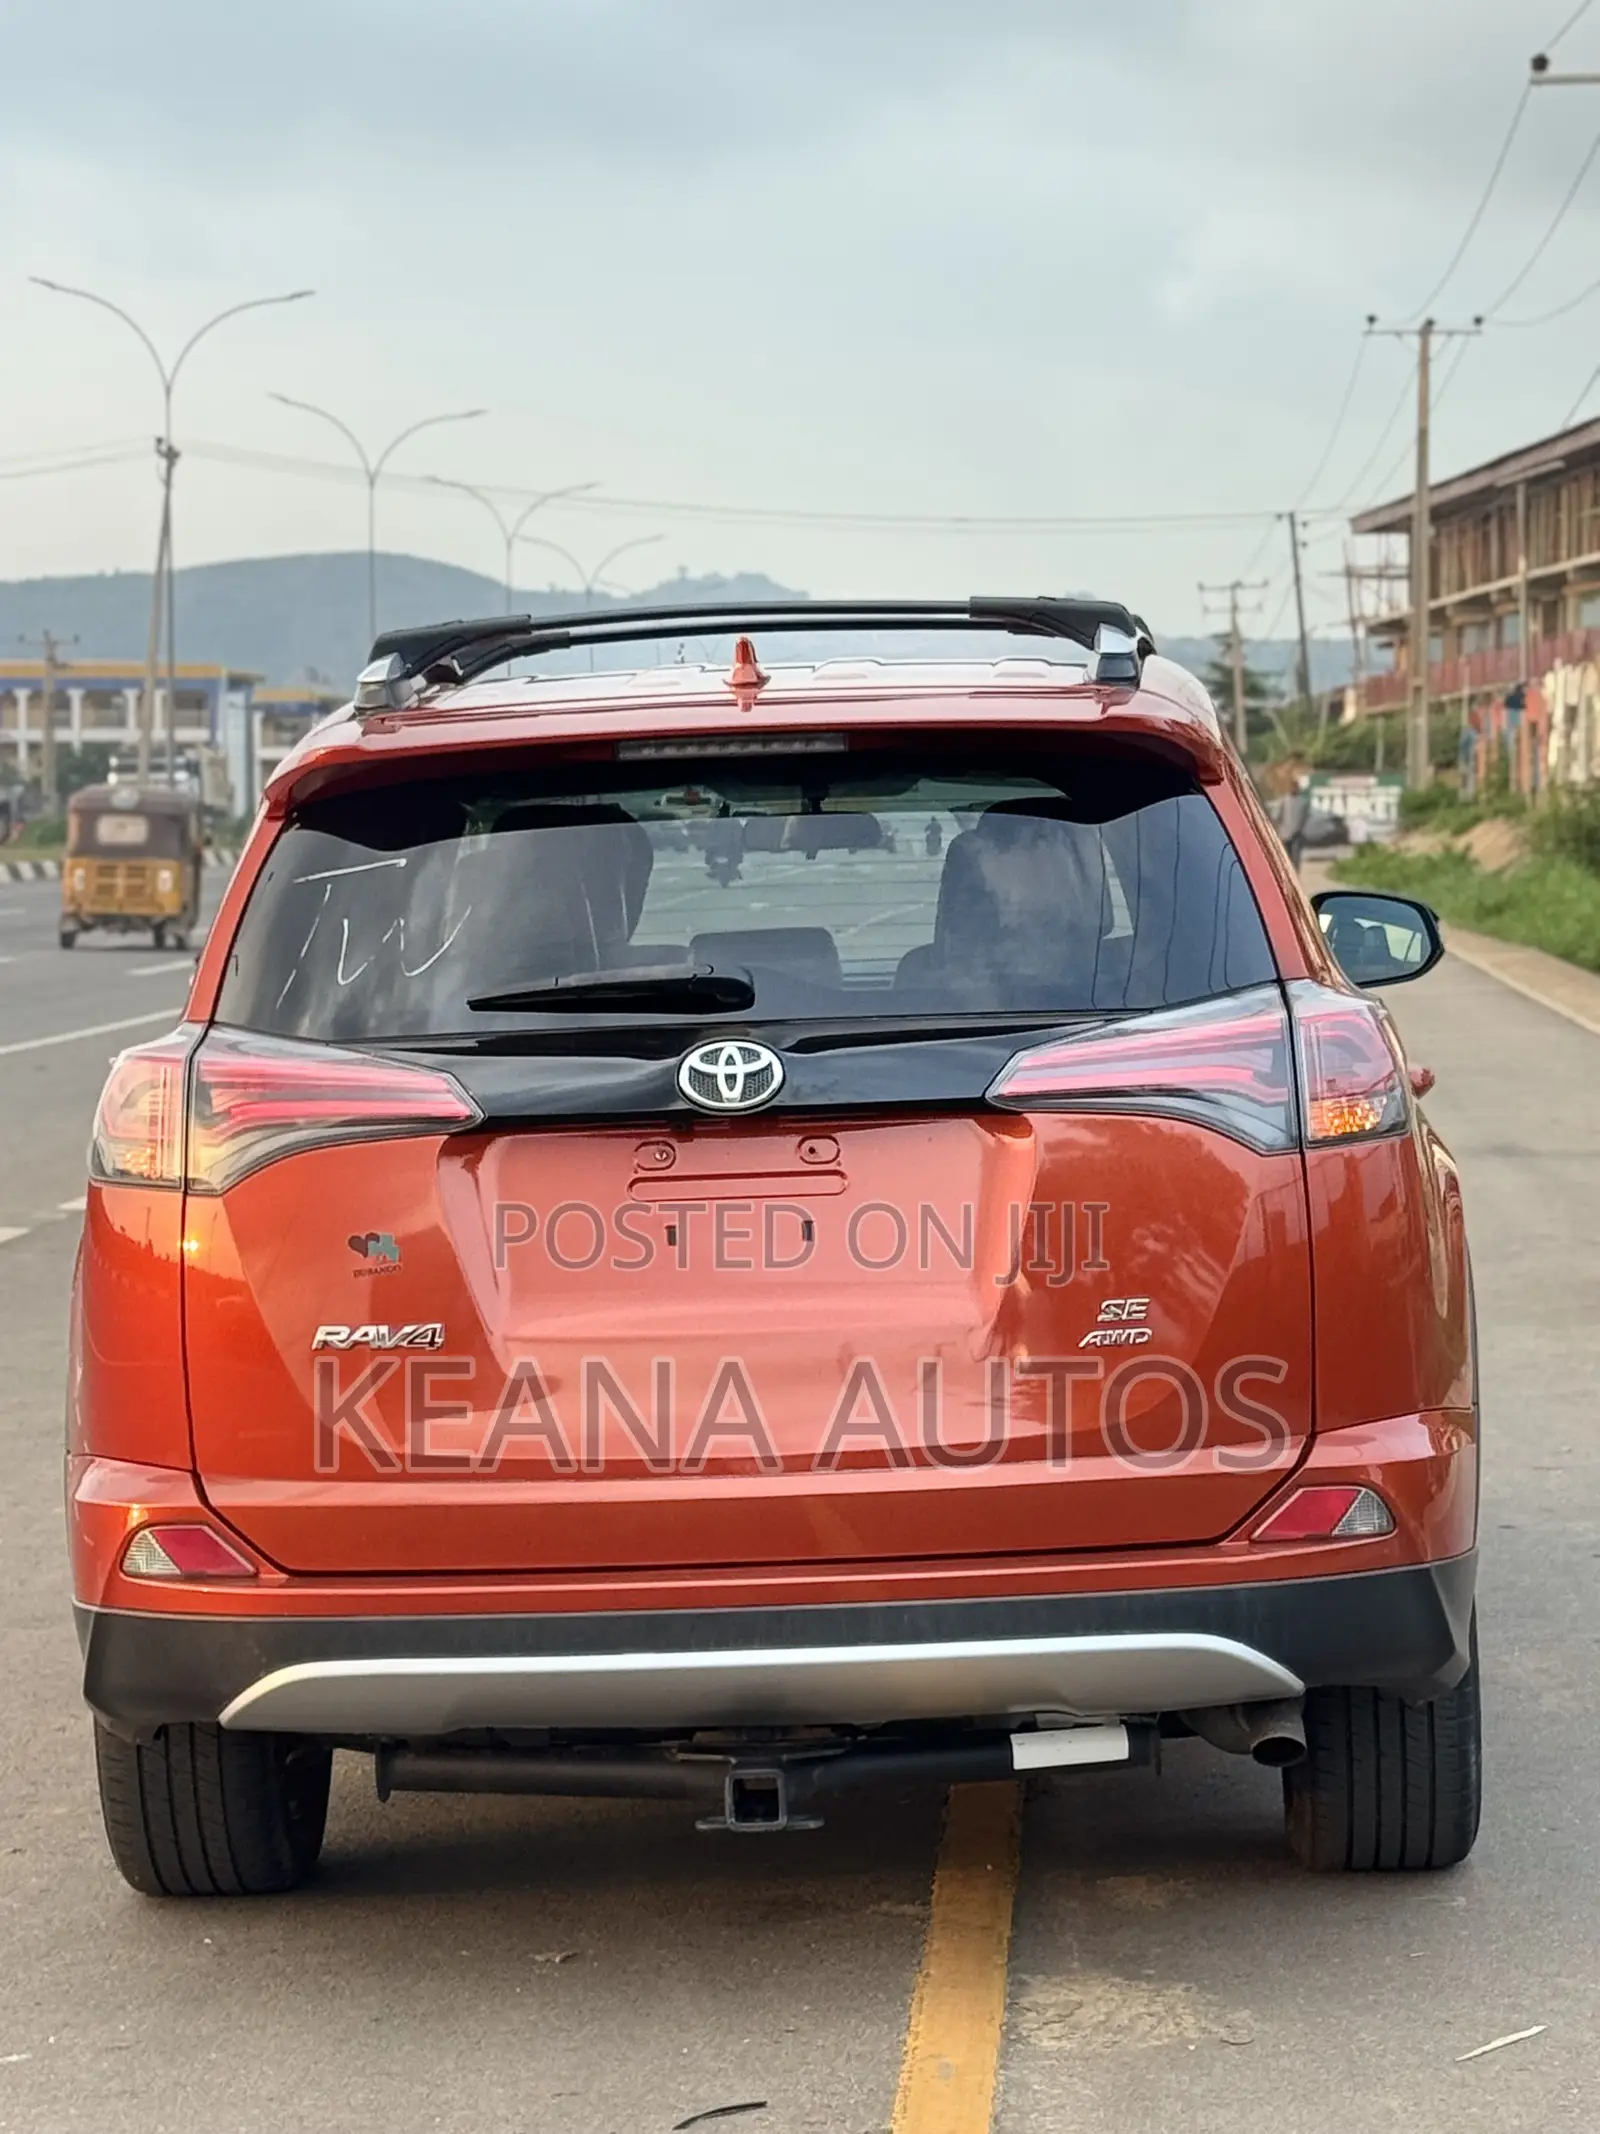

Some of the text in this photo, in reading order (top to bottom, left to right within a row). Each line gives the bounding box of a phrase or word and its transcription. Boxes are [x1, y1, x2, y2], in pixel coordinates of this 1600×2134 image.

[1097, 1297, 1150, 1322] SE
[311, 1322, 445, 1351] RAV4
[1078, 1327, 1152, 1348] AWD
